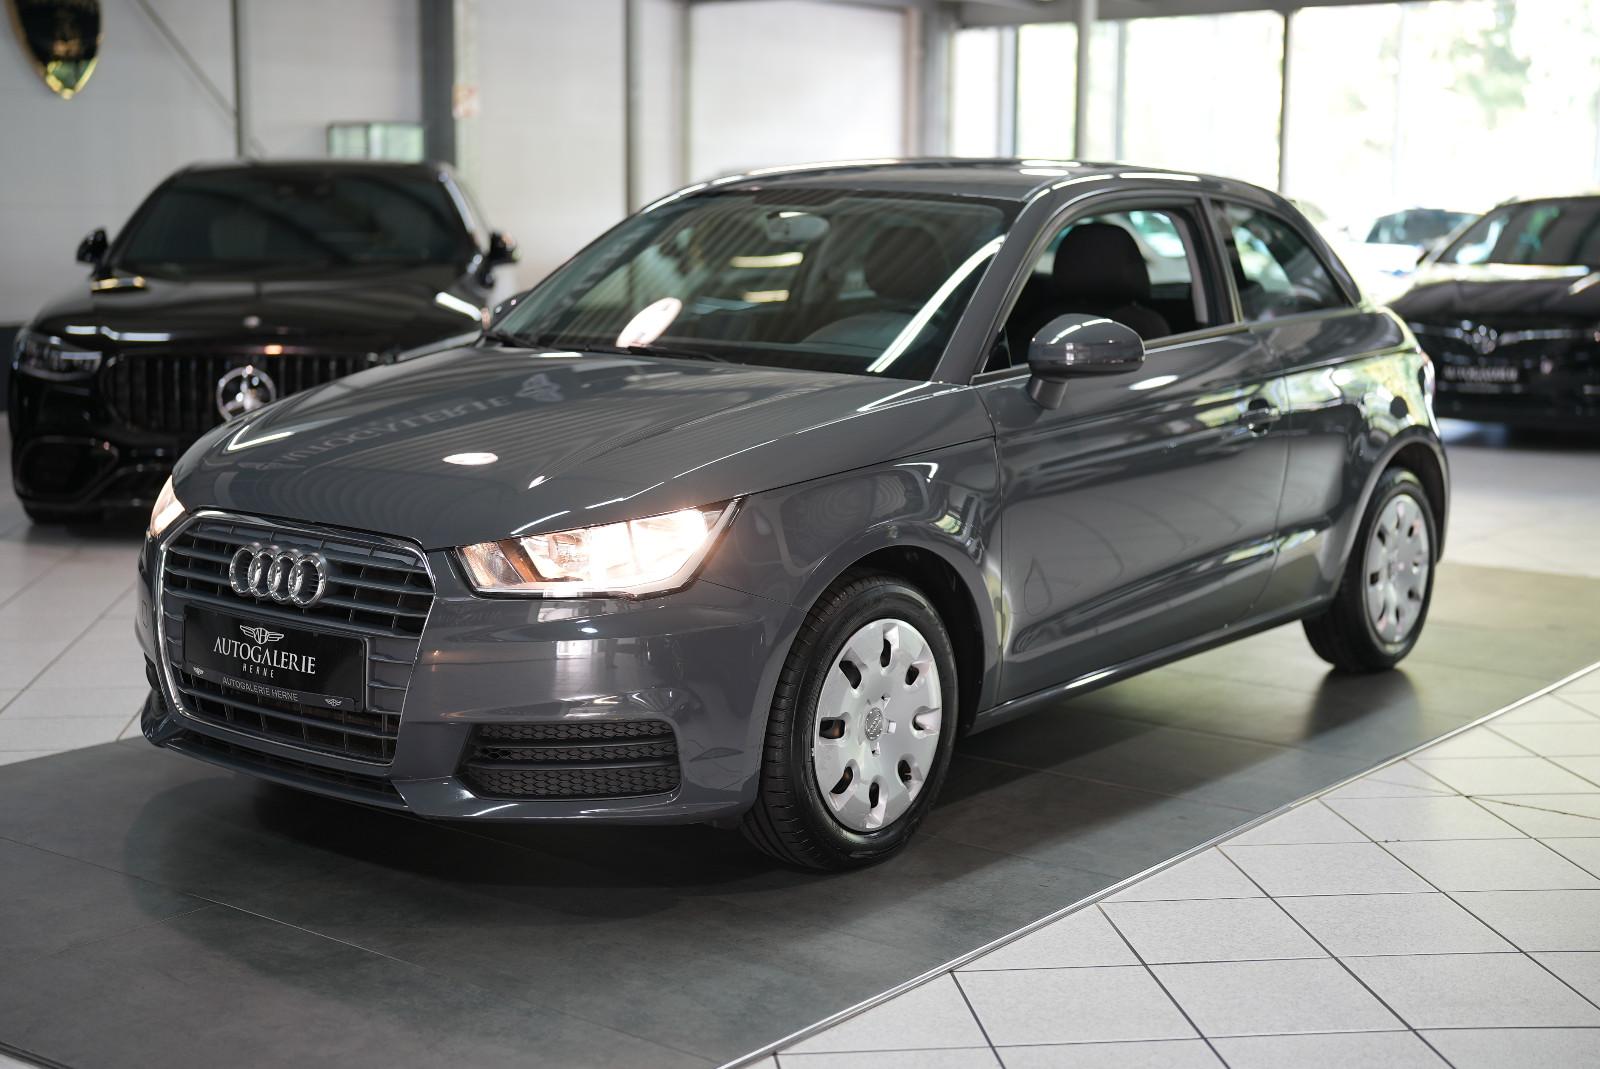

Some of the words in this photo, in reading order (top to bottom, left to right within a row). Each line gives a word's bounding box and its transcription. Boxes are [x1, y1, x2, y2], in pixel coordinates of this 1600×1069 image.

[213, 636, 316, 674] AUTOGALERIE
[242, 663, 275, 679] HERNE
[222, 677, 271, 698] AUTOGALERIE
[271, 688, 299, 702] HERNE
